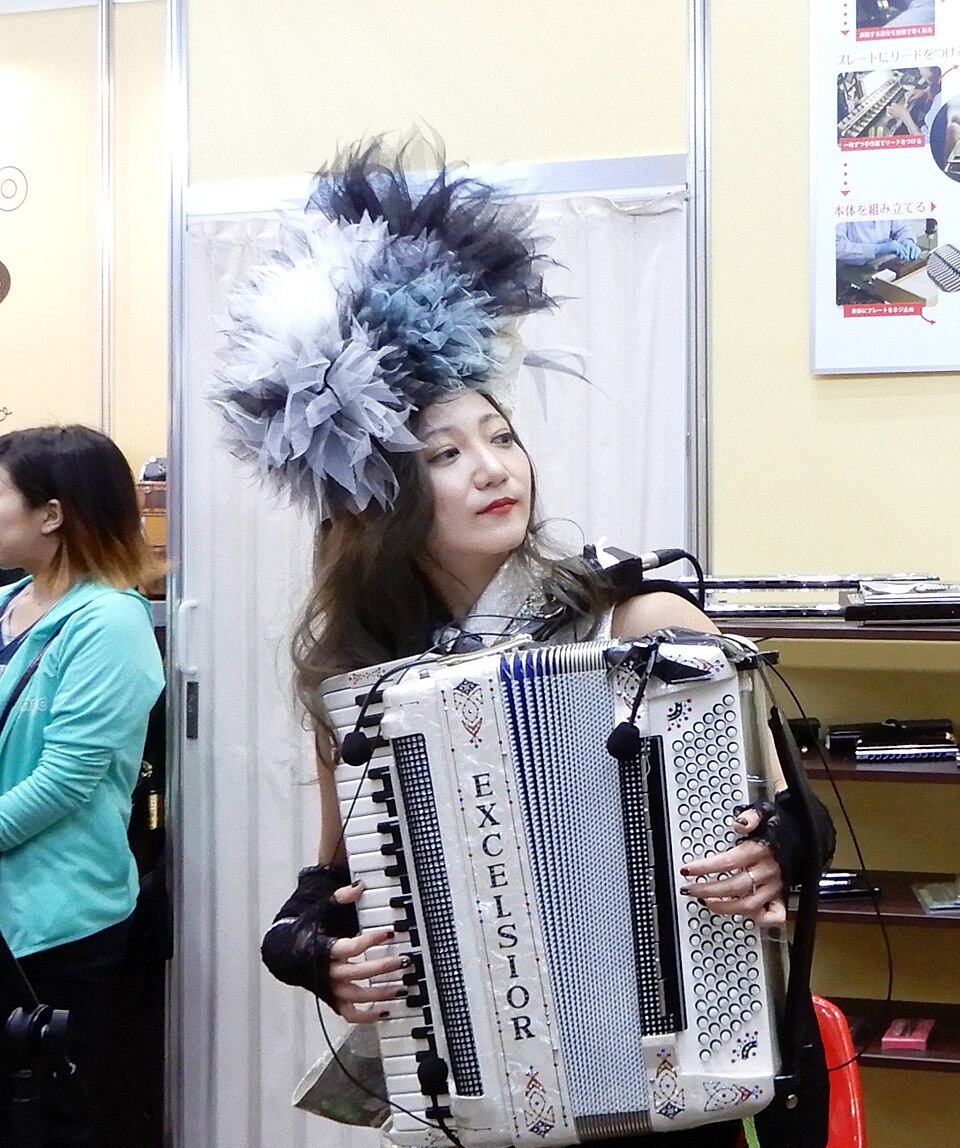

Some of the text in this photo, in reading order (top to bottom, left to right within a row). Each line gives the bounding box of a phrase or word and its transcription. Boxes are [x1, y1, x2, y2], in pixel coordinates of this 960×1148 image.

[833, 201, 926, 217] 本体を組み立てる
[473, 772, 536, 1041] EXCELSIOR
